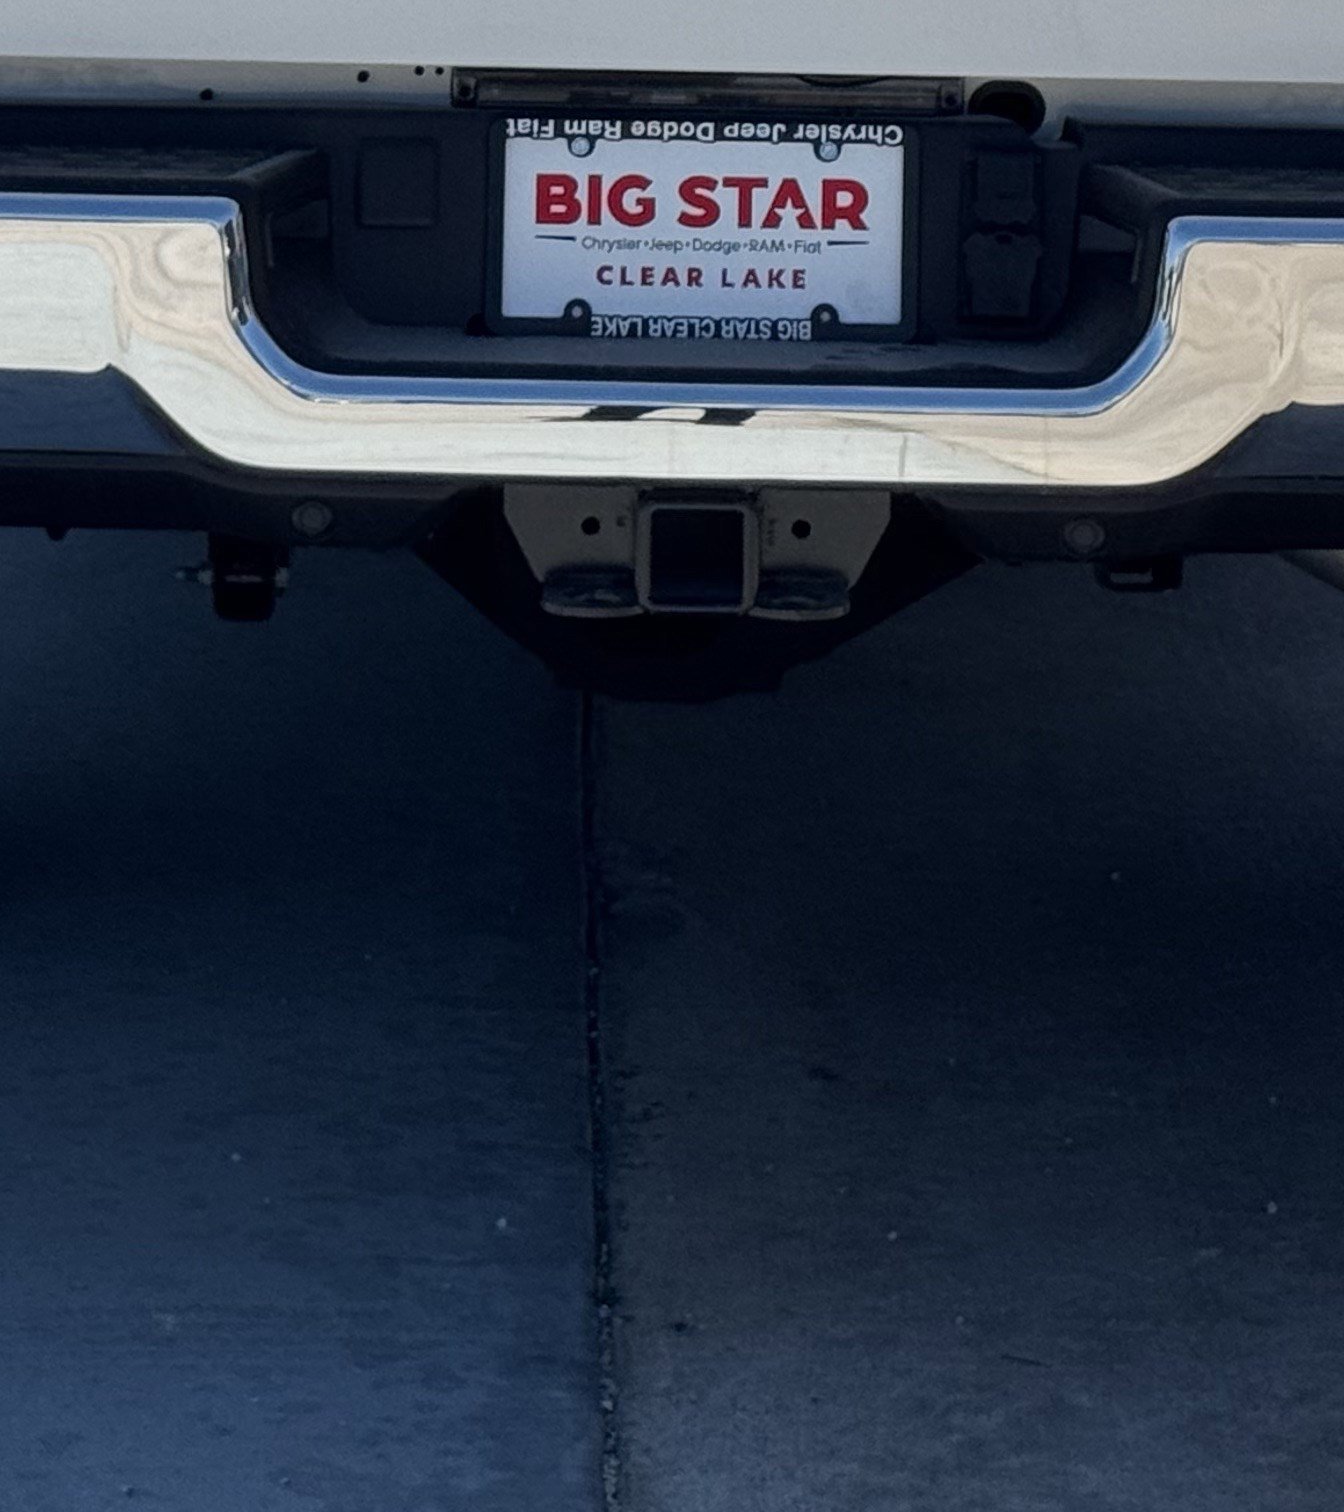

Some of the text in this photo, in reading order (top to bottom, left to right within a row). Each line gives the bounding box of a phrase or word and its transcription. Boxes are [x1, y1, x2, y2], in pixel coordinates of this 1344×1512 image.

[506, 118, 904, 145] Chrysler Jeep Dodge Ram Fiat
[535, 173, 870, 231] BIG STAR
[596, 265, 807, 289] CLEAR LAKE
[590, 316, 812, 340] BIG STAR CLEAR LAKE
